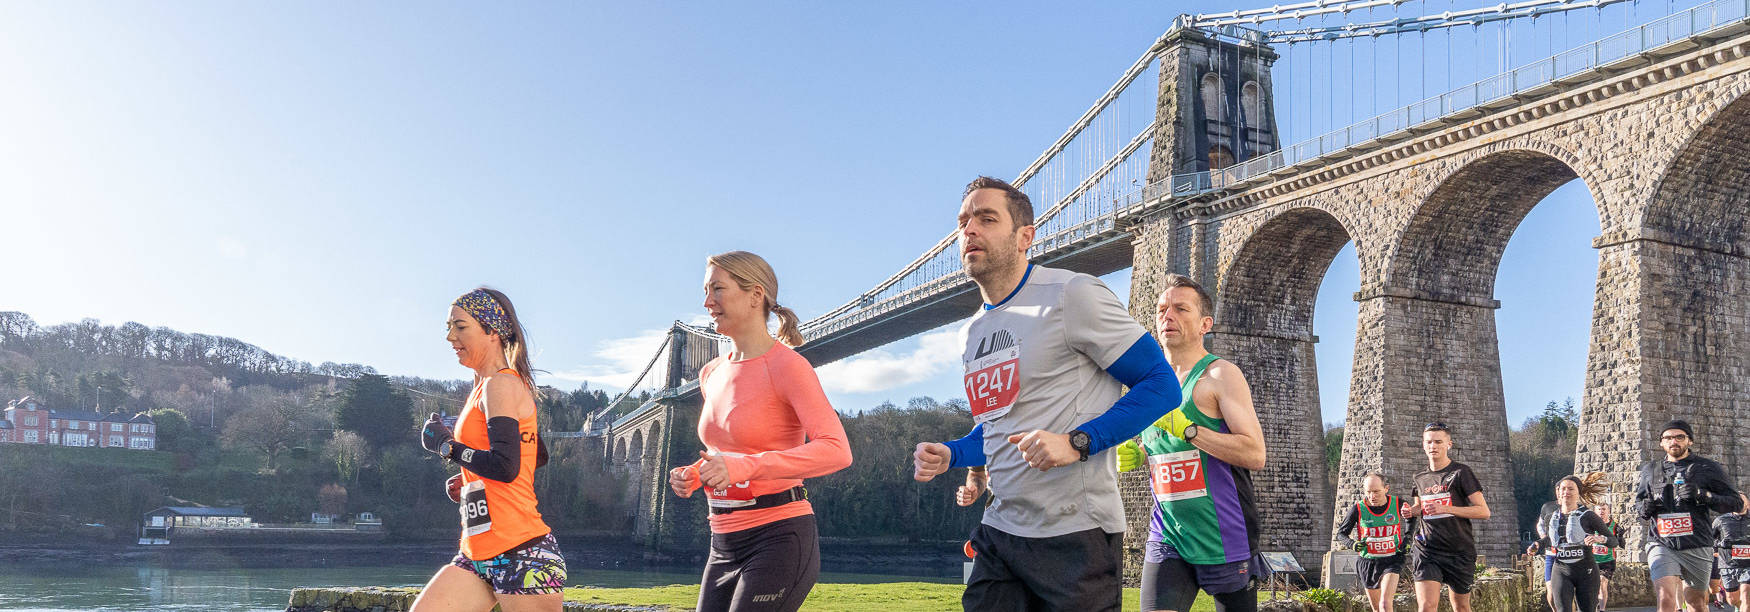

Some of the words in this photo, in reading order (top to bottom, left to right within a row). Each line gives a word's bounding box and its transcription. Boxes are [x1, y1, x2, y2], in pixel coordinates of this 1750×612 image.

[966, 363, 1016, 401] 1247
[986, 396, 998, 408] LEE
[1658, 518, 1691, 529] 1333
[1368, 541, 1396, 551] 1600
